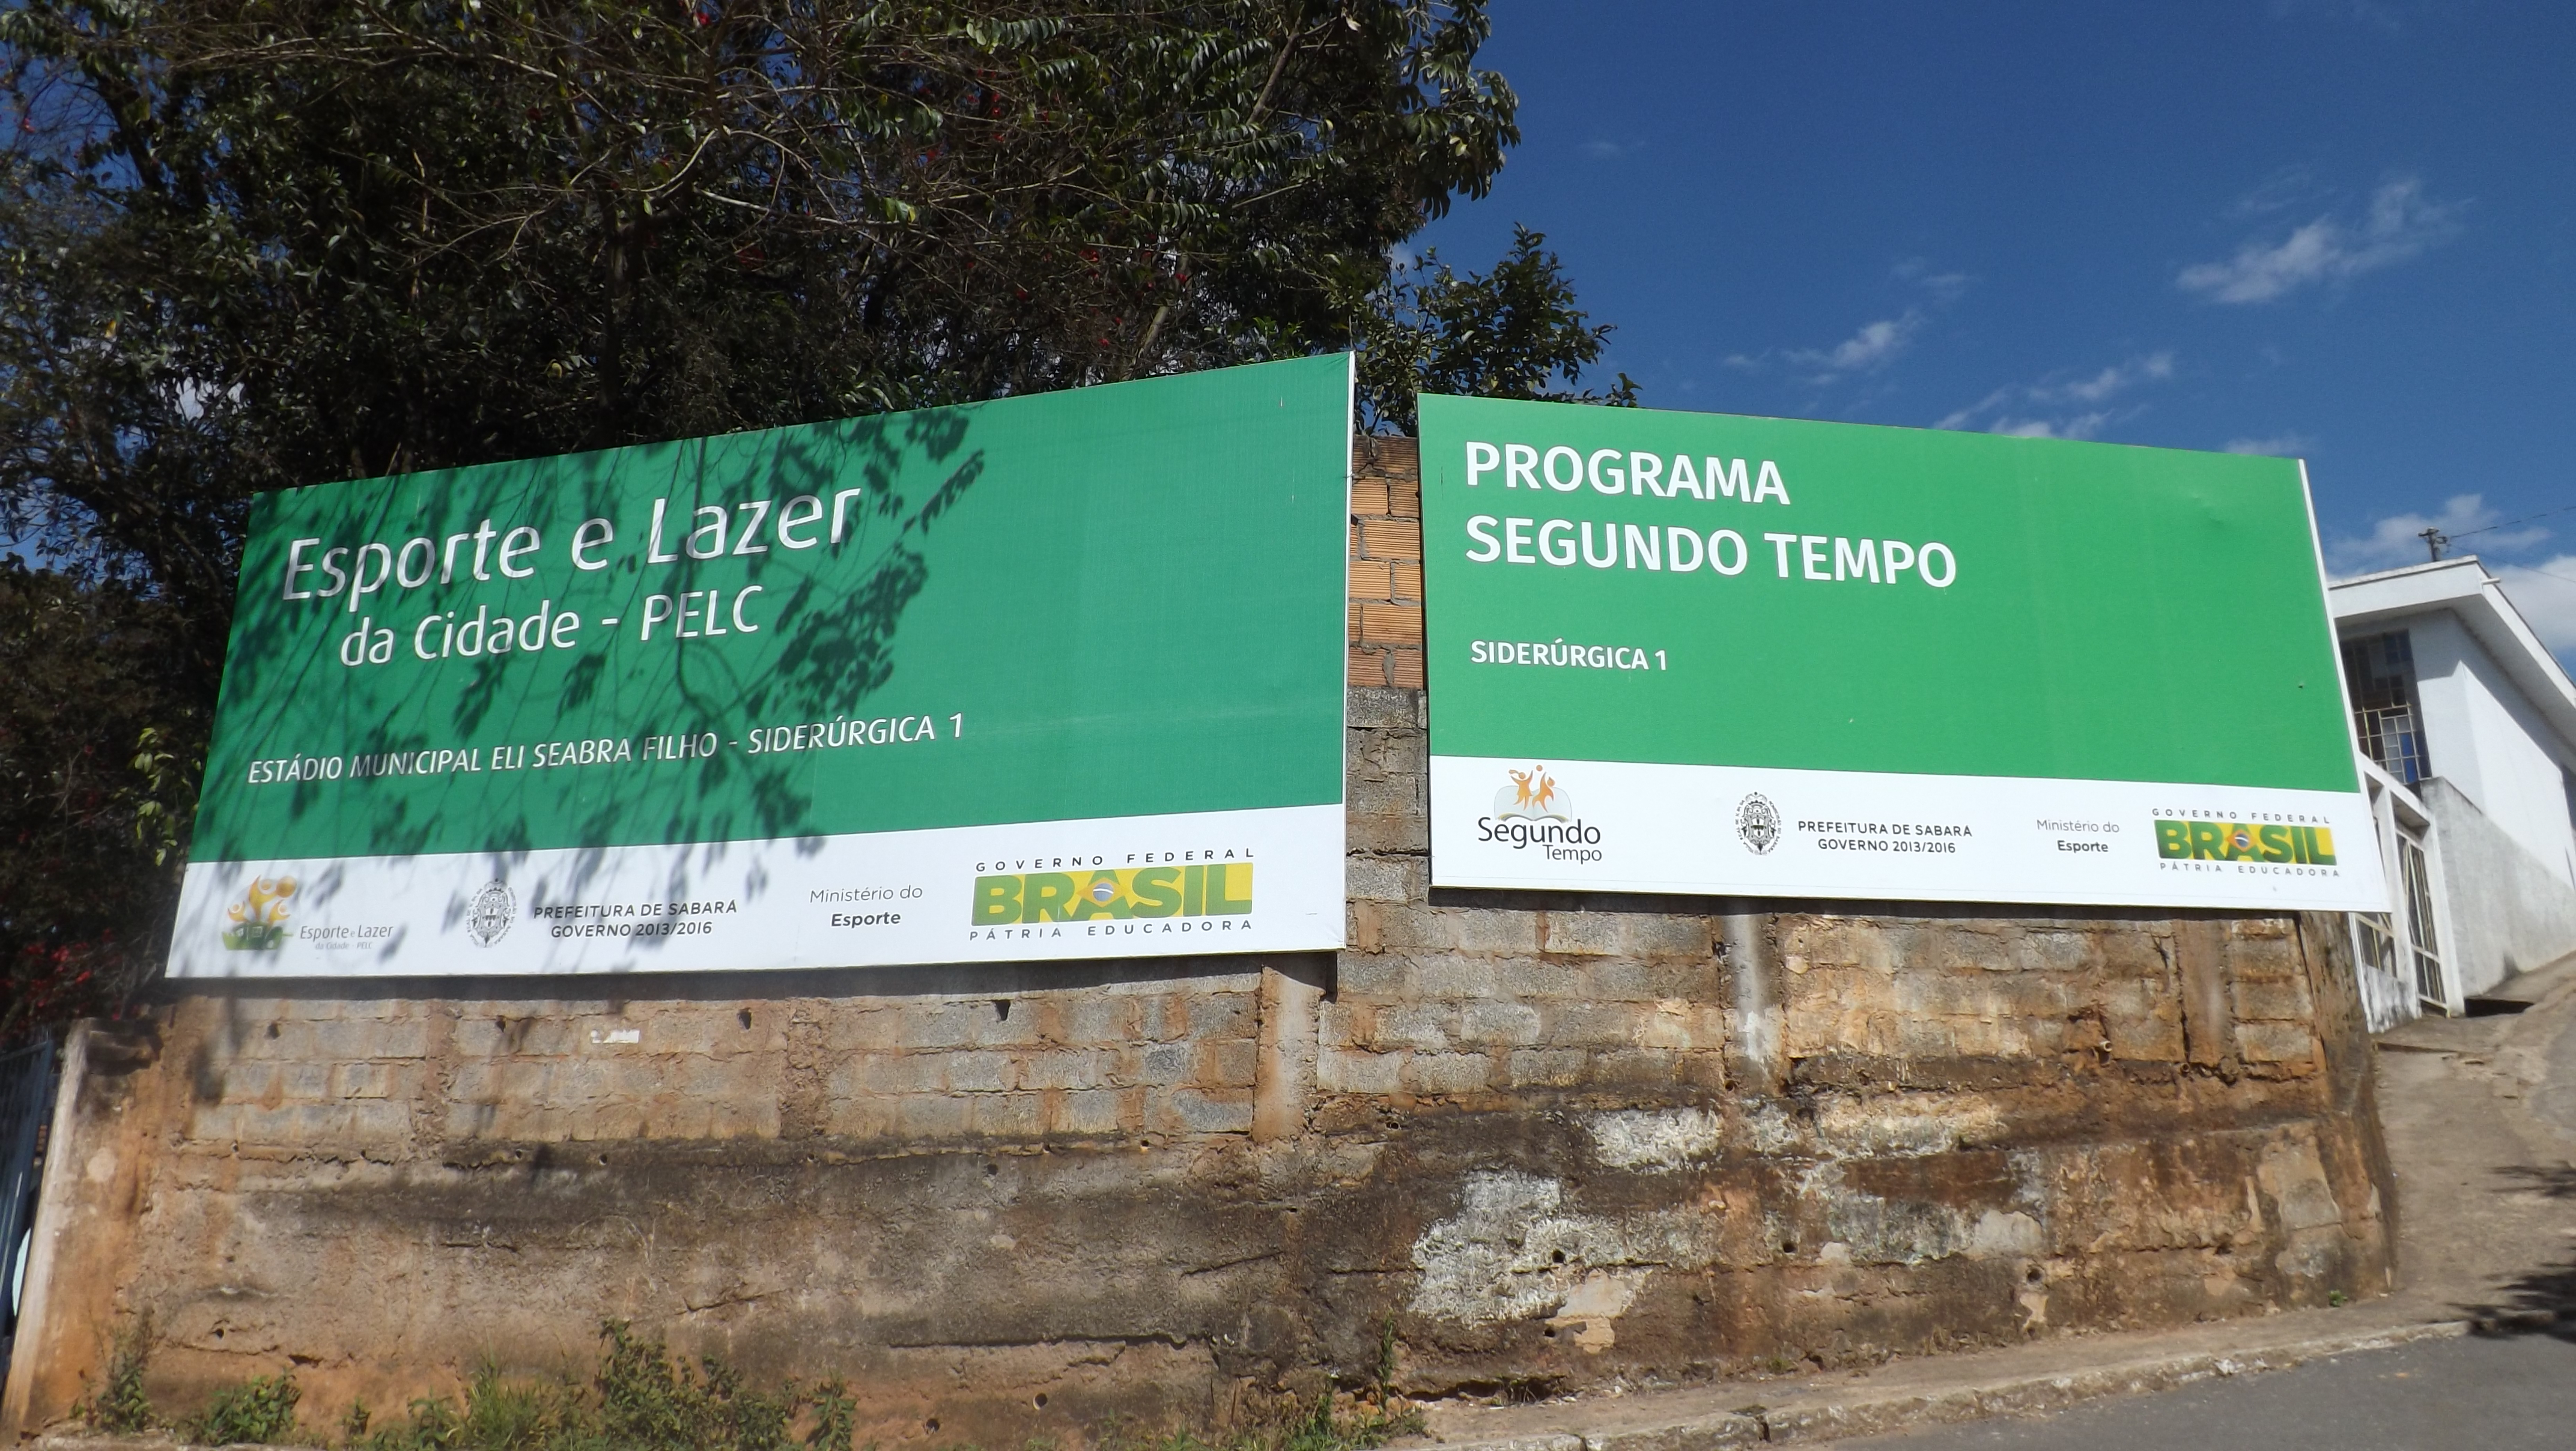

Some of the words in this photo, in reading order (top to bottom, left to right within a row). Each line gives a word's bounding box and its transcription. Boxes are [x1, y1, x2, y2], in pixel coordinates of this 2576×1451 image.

[1466, 441, 1790, 504] PROGRAMA
[283, 518, 540, 612] Esporte
[571, 518, 613, 569] e
[648, 488, 860, 563] Lazer
[1466, 515, 1748, 575] SEGUNDO
[1764, 533, 1957, 587] TEMPO
[339, 617, 395, 667] da
[413, 600, 580, 660] Cidade
[640, 585, 764, 641] PELC
[1471, 638, 1648, 670] SIDERÚRGICA
[1654, 649, 1667, 670] 1
[248, 753, 342, 783] ESTÁDIO
[350, 748, 481, 778] MUNICIPAL
[491, 745, 524, 770] ELI
[532, 738, 631, 768] SEABRA
[643, 733, 717, 760] FILHO
[747, 715, 935, 753] SIDERÚRGICA
[949, 713, 962, 738] 1
[2152, 808, 2237, 819] GOVERNO
[2252, 813, 2330, 824] FEDERAL
[1478, 816, 1601, 849] Segundo
[1798, 820, 1888, 835] PREFEITURA
[1892, 825, 1911, 835] DE
[2037, 819, 2099, 833] Ministério
[2103, 822, 2119, 833] do
[1818, 839, 1889, 852] GOVERNO
[1892, 841, 1956, 853] 2013/2016
[2058, 840, 2109, 853] Esporte
[2155, 820, 2337, 865] BRASIL
[976, 855, 1104, 872] GOVERNO
[1127, 848, 1254, 864] FEDERAL
[1542, 844, 1602, 865] Tempo
[2160, 861, 2222, 873] PÁTRIA
[2238, 865, 2339, 877] EDUCADORA
[810, 886, 894, 903] Ministério
[899, 885, 923, 899] do
[972, 864, 1253, 925] BRASIL
[533, 905, 635, 919] PREFEITURA
[640, 904, 663, 916] DE
[831, 910, 901, 928] Esporte
[300, 925, 349, 942] Esporte
[357, 925, 393, 938] Lazer
[551, 925, 631, 938] GOVERNO
[636, 921, 712, 936] 2013/2016
[970, 928, 1063, 941] PÁTRIA
[1089, 919, 1251, 936] EDUCADORA
[326, 942, 348, 950] Cidade
